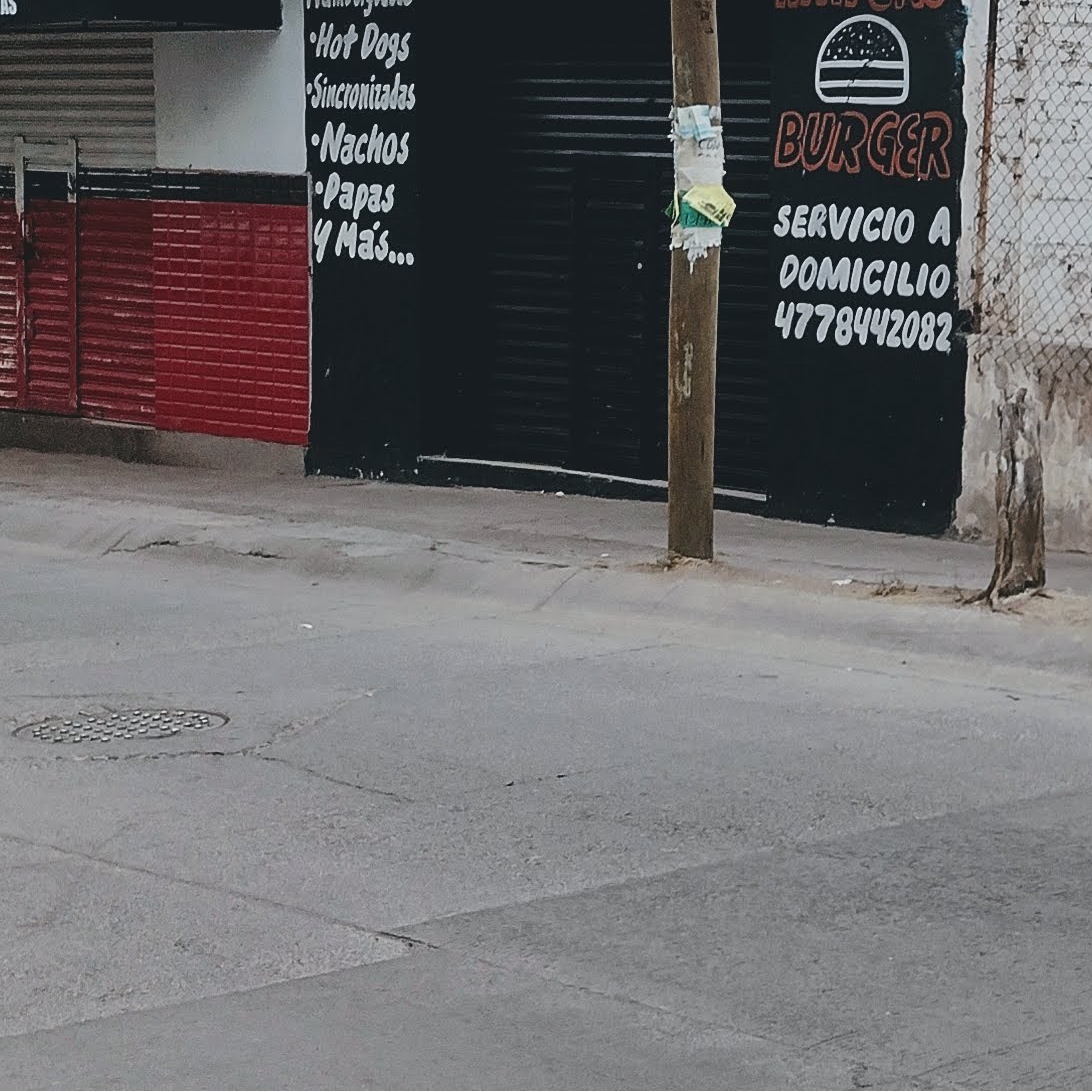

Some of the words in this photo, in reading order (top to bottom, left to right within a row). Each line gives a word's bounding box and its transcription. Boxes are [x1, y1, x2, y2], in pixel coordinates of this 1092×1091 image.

[316, 22, 358, 59] Hot
[361, 23, 411, 68] Dogs
[311, 73, 416, 110] Sincronizadas
[320, 121, 409, 165] Nachos
[774, 111, 953, 180] BURGER
[324, 172, 395, 219] Papas
[773, 204, 915, 245] SERVICIO
[928, 207, 951, 246] A
[779, 254, 951, 299] DOMICILIO
[774, 301, 953, 352] 4778442082
